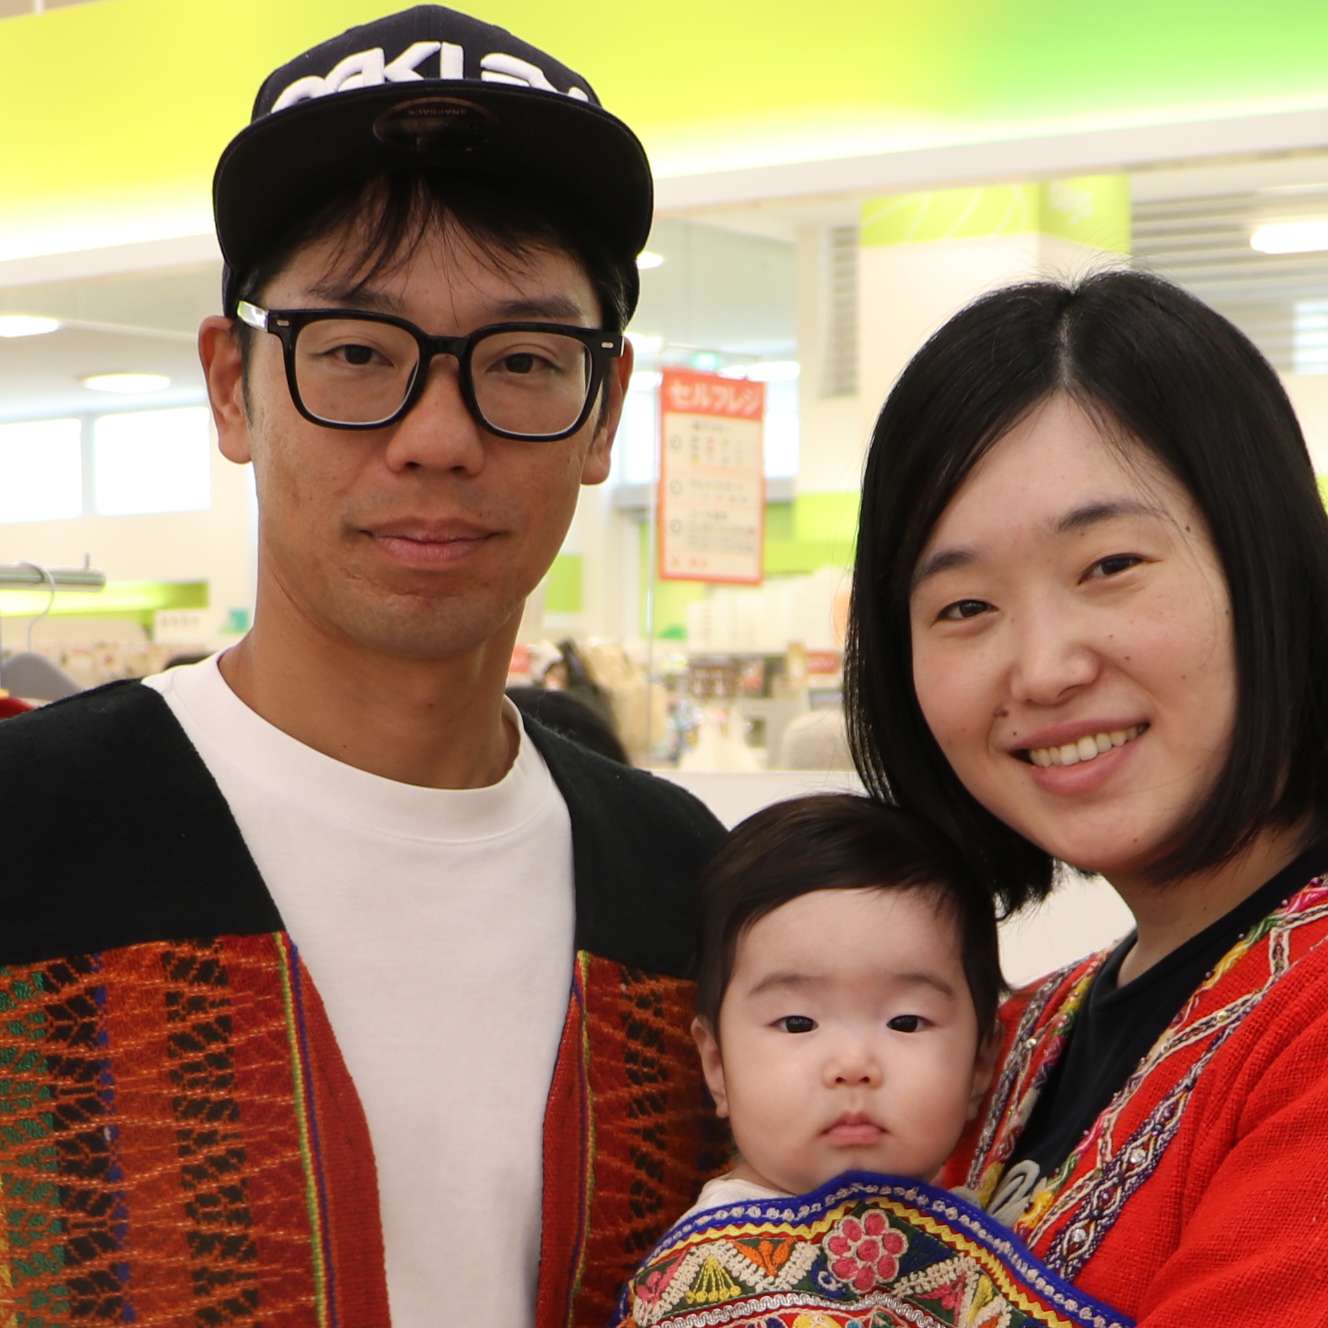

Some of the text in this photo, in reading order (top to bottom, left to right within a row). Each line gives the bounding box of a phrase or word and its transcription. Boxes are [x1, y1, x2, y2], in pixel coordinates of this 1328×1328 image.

[670, 379, 763, 414] セルフレジ
